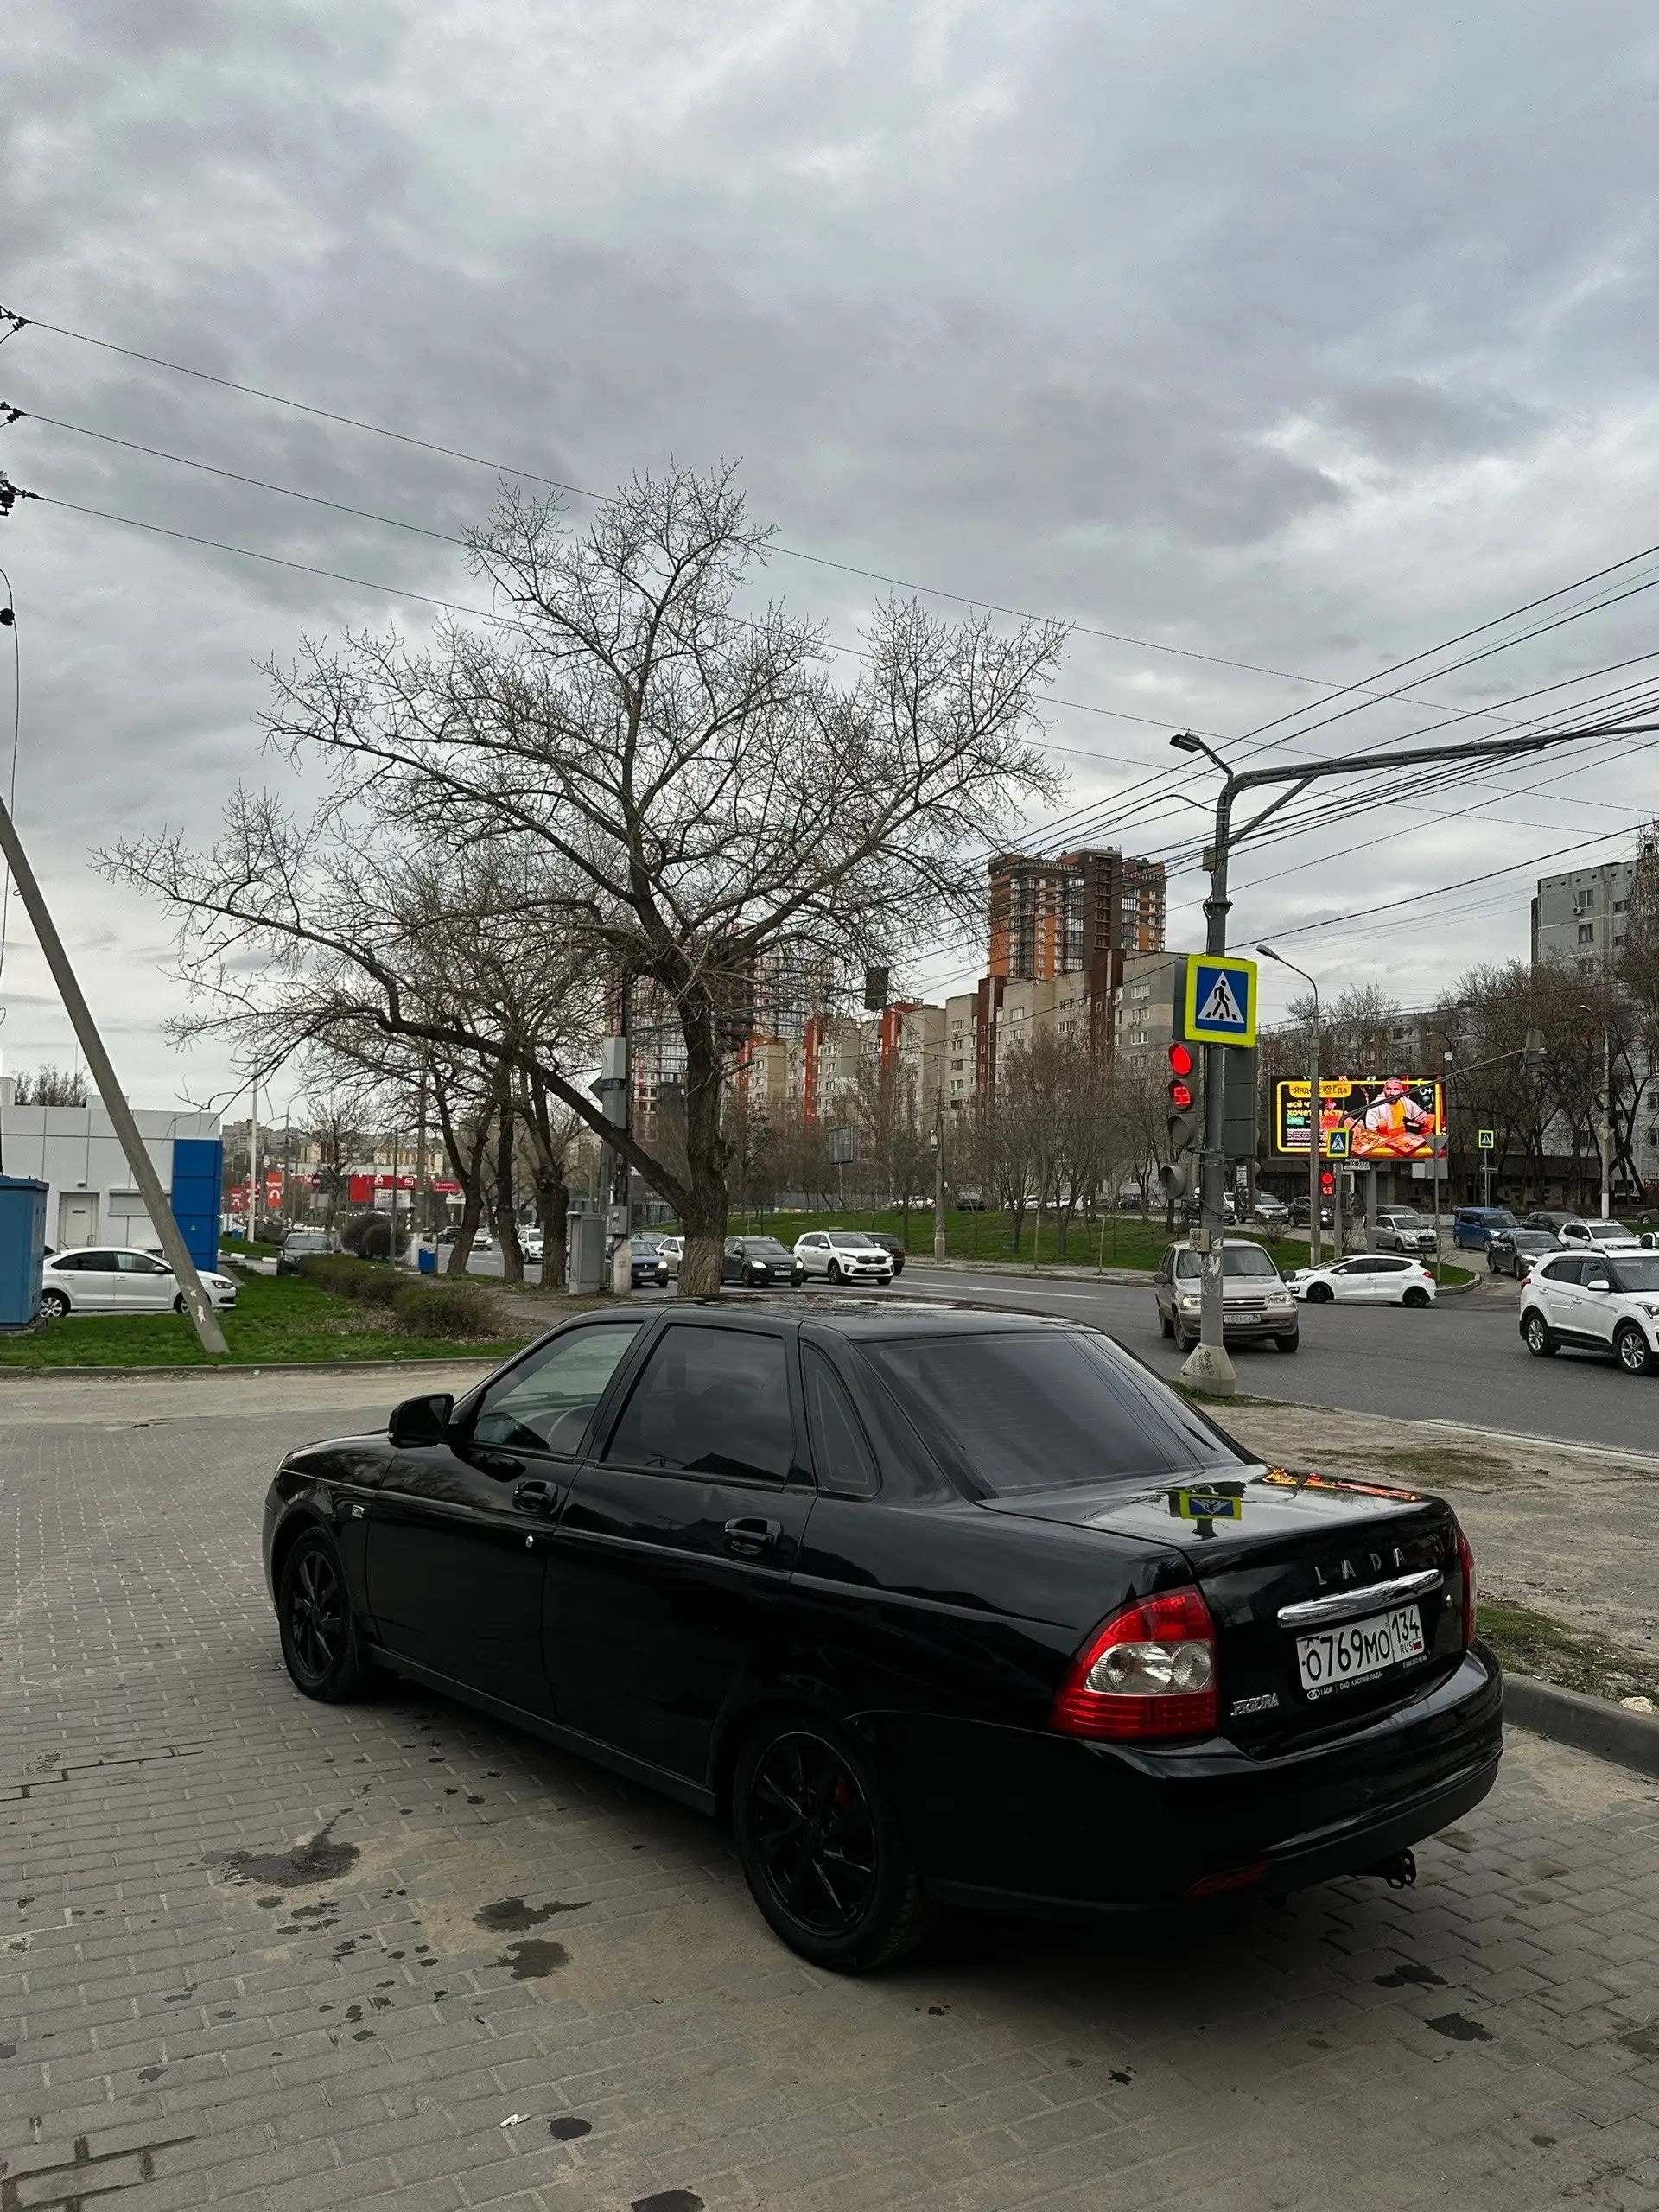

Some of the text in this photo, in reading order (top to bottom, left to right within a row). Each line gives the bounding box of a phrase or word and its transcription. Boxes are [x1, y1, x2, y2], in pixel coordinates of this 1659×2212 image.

[1332, 1085, 1347, 1094] Еда
[1313, 1548, 1407, 1585] LADA
[1306, 1608, 1420, 1681] О769МО 134
[1399, 1642, 1414, 1656] RUS
[1320, 1686, 1333, 1696] LADA
